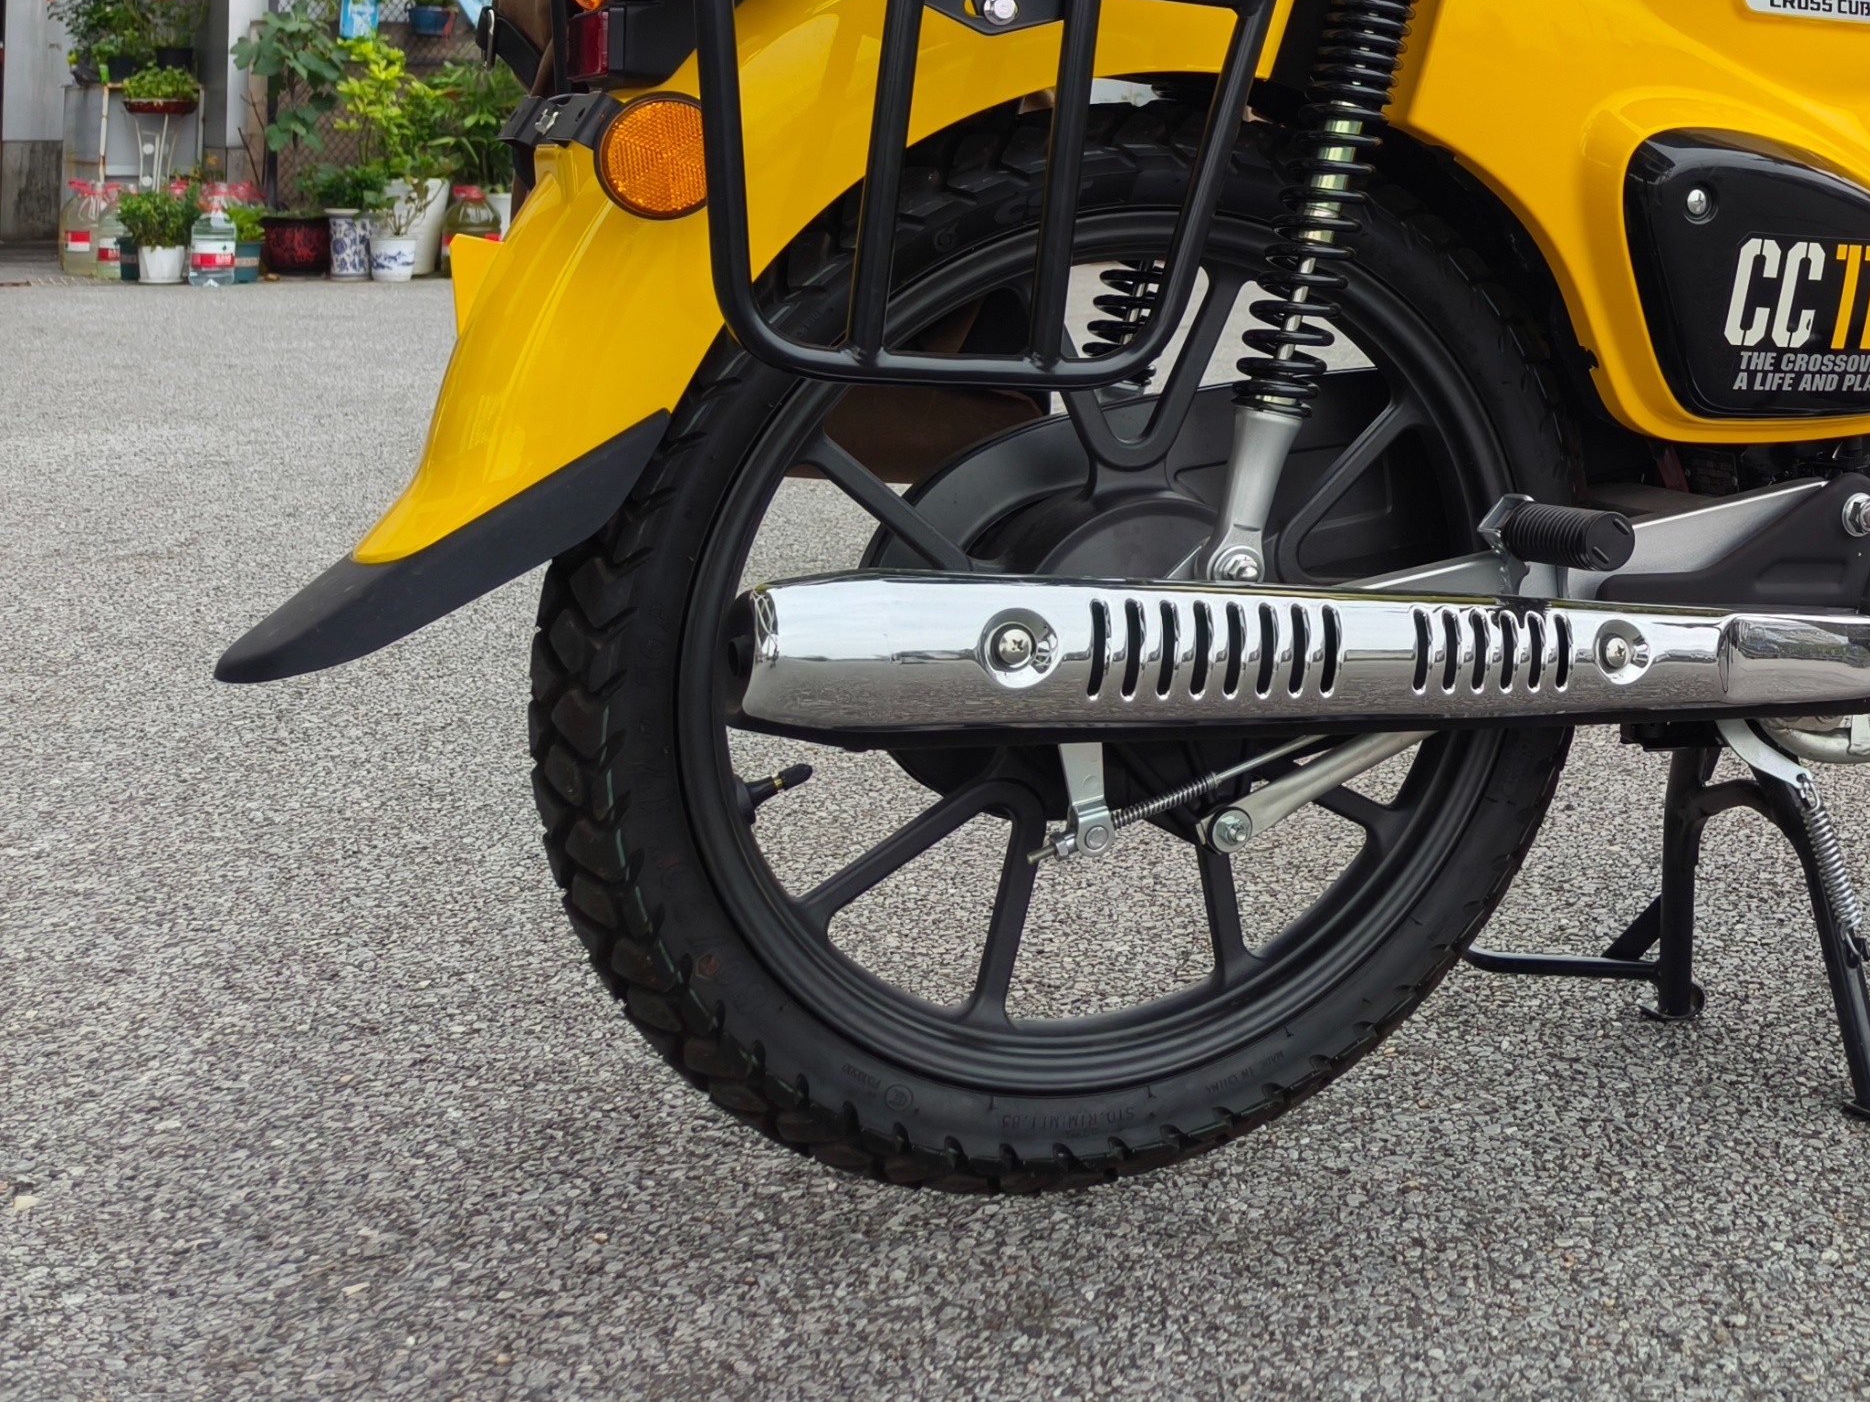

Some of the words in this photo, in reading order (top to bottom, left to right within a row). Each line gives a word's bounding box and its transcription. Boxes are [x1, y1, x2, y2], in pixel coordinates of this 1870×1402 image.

[1739, 351, 1777, 371] THE
[1733, 372, 1748, 391] A
[1754, 373, 1793, 391] LIFE
[1799, 373, 1839, 392] AND
